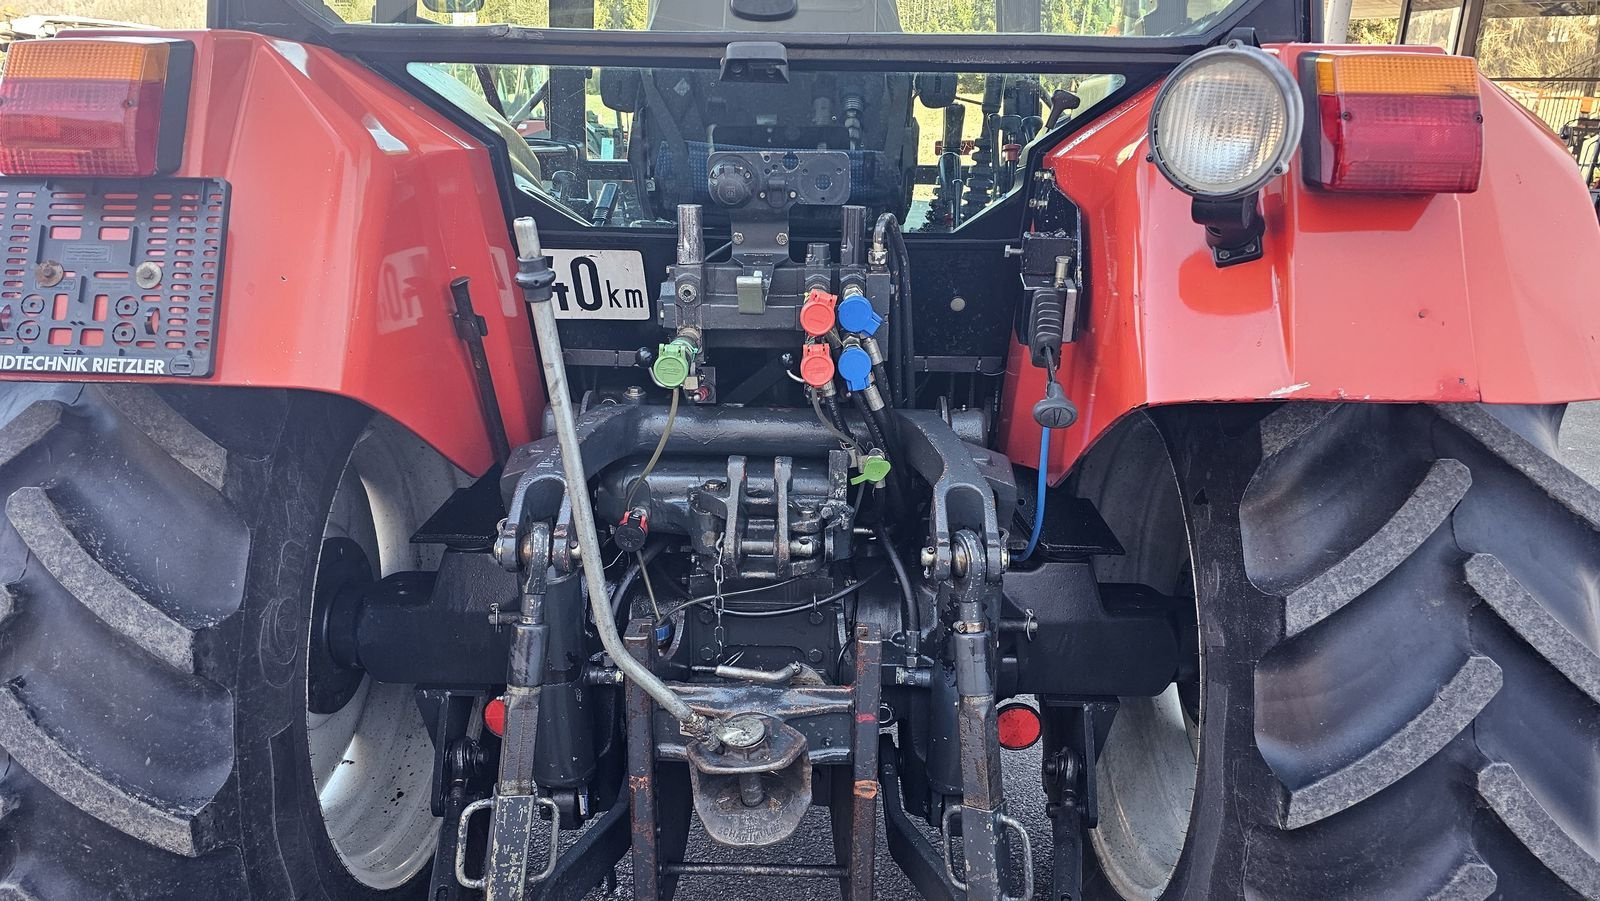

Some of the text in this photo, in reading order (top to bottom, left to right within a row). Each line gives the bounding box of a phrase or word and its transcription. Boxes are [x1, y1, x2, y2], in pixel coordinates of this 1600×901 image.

[606, 280, 643, 308] km
[0, 355, 165, 374] DTECHNIK RIETZLER
